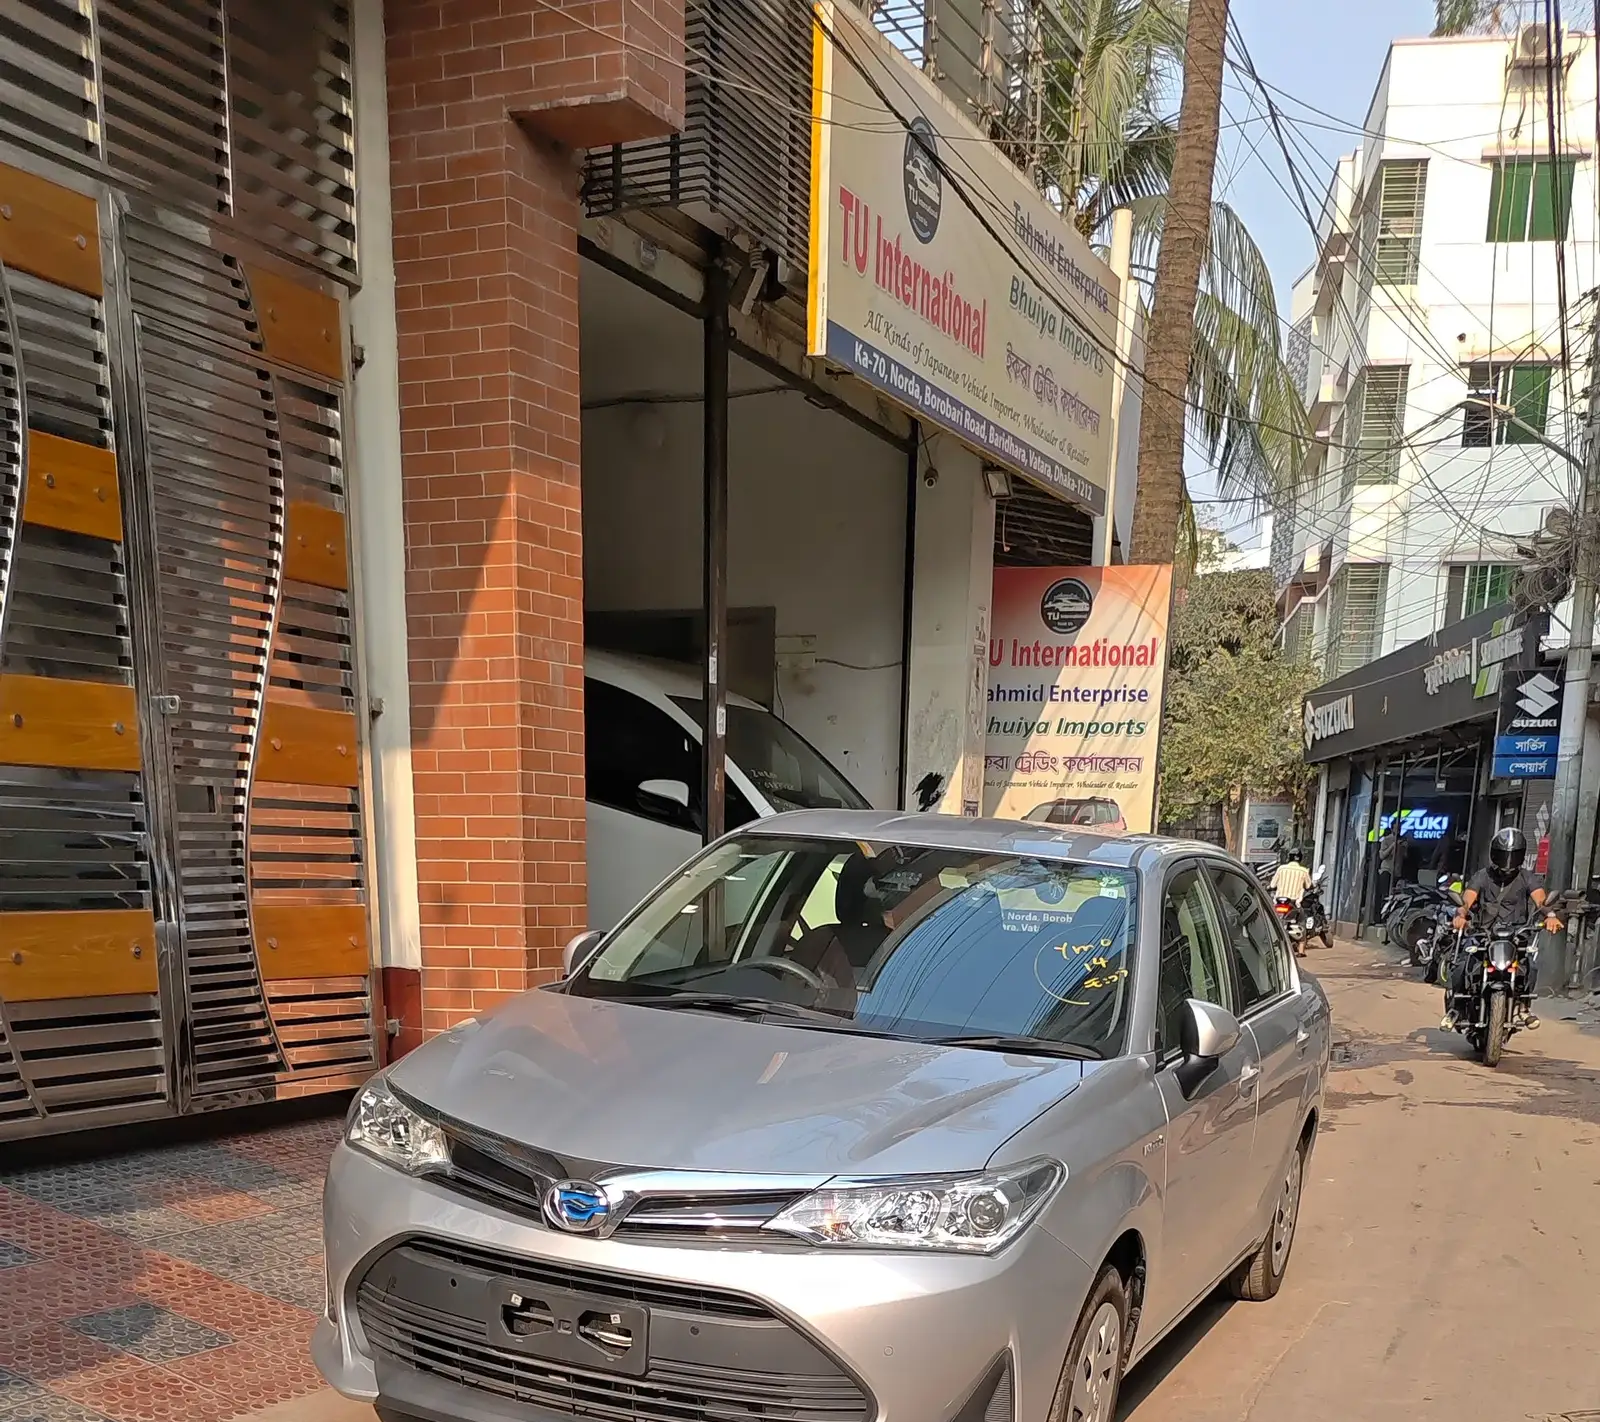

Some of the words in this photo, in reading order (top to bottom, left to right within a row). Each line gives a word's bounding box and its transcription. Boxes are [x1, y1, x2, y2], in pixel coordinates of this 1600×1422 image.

[908, 183, 918, 205] TU
[1013, 200, 1056, 267] Tahmid
[1058, 242, 1109, 313] Enterprise
[840, 186, 869, 275] TU
[875, 214, 987, 360] International
[1009, 275, 1056, 337] Bhuiya
[1059, 315, 1104, 374] Imports
[864, 310, 883, 334] All
[884, 320, 911, 353] Kinds
[912, 342, 924, 364] of
[923, 348, 960, 385] Japanese
[961, 373, 989, 403] Vehicle
[989, 392, 1021, 428] Importer,
[1023, 413, 1058, 447] Wholesaler
[854, 340, 888, 383] Ka-70,
[889, 363, 922, 405] Norda,
[924, 385, 963, 426] Borobari
[963, 410, 988, 443] Road,
[988, 425, 1028, 466] Baridhara,
[1028, 448, 1053, 482] Vatara,
[1053, 464, 1093, 501] Dhaka-1212
[1047, 612, 1060, 621] TU
[989, 638, 1004, 667] U
[1011, 637, 1157, 667] International
[987, 684, 1044, 702] ahmid
[1050, 684, 1149, 707] Enterprise
[986, 716, 1050, 738] huiya
[1056, 717, 1146, 739] Imports
[1314, 694, 1354, 740] SUZUKI
[1511, 718, 1557, 728] SUZUKI
[1515, 737, 1547, 752] সার্ভিস
[984, 755, 1010, 771] করা
[1015, 750, 1058, 774] ট্রেডিং
[1063, 753, 1143, 772] কর্পোরেশন
[1413, 830, 1446, 839] SERVIC
